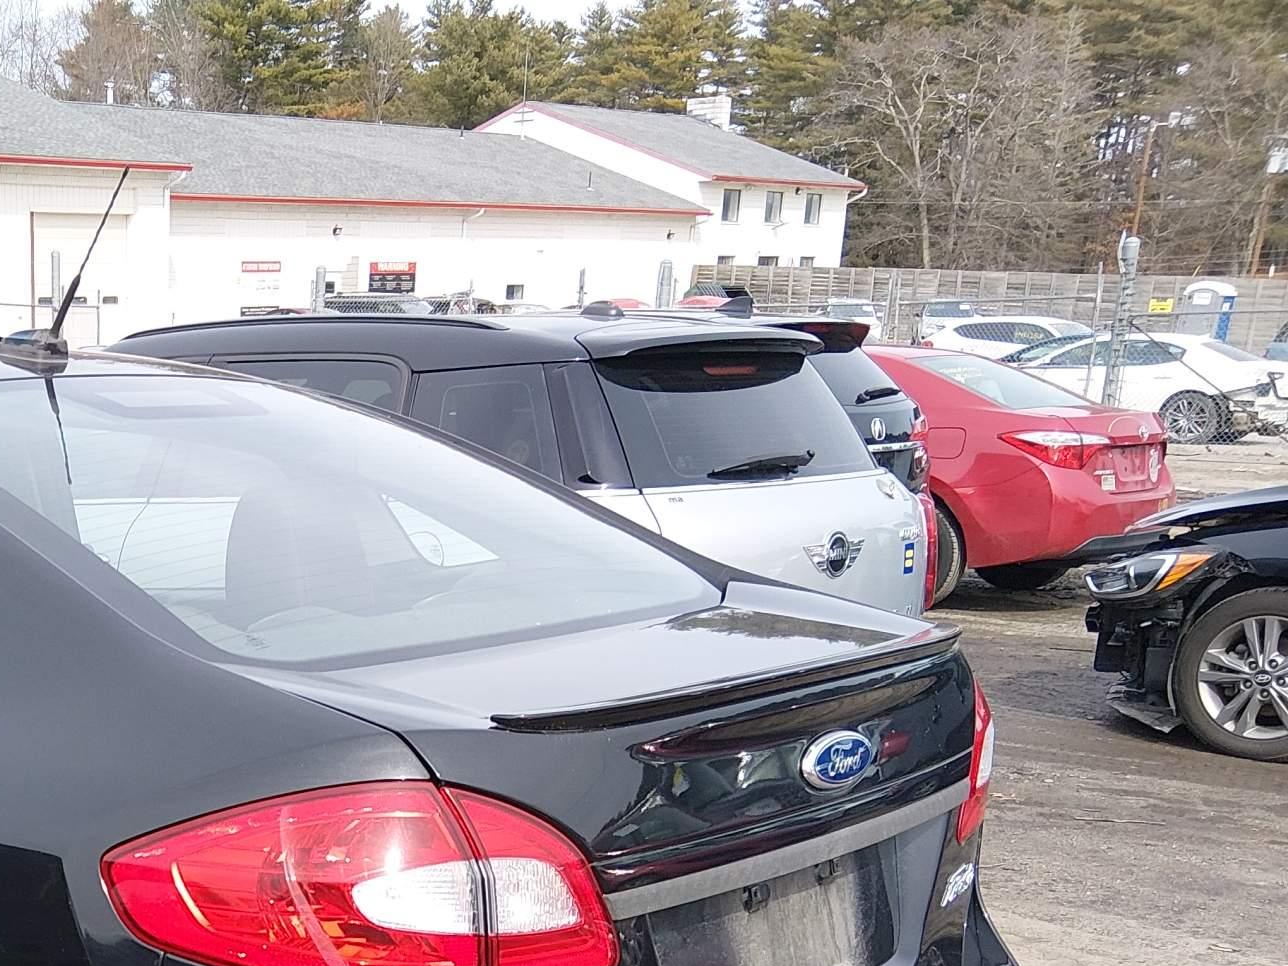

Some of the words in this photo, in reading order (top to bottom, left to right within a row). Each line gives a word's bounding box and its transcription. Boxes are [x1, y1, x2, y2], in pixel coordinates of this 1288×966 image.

[378, 261, 409, 272] WARNING
[829, 546, 848, 561] MINI
[822, 741, 867, 777] Ford
